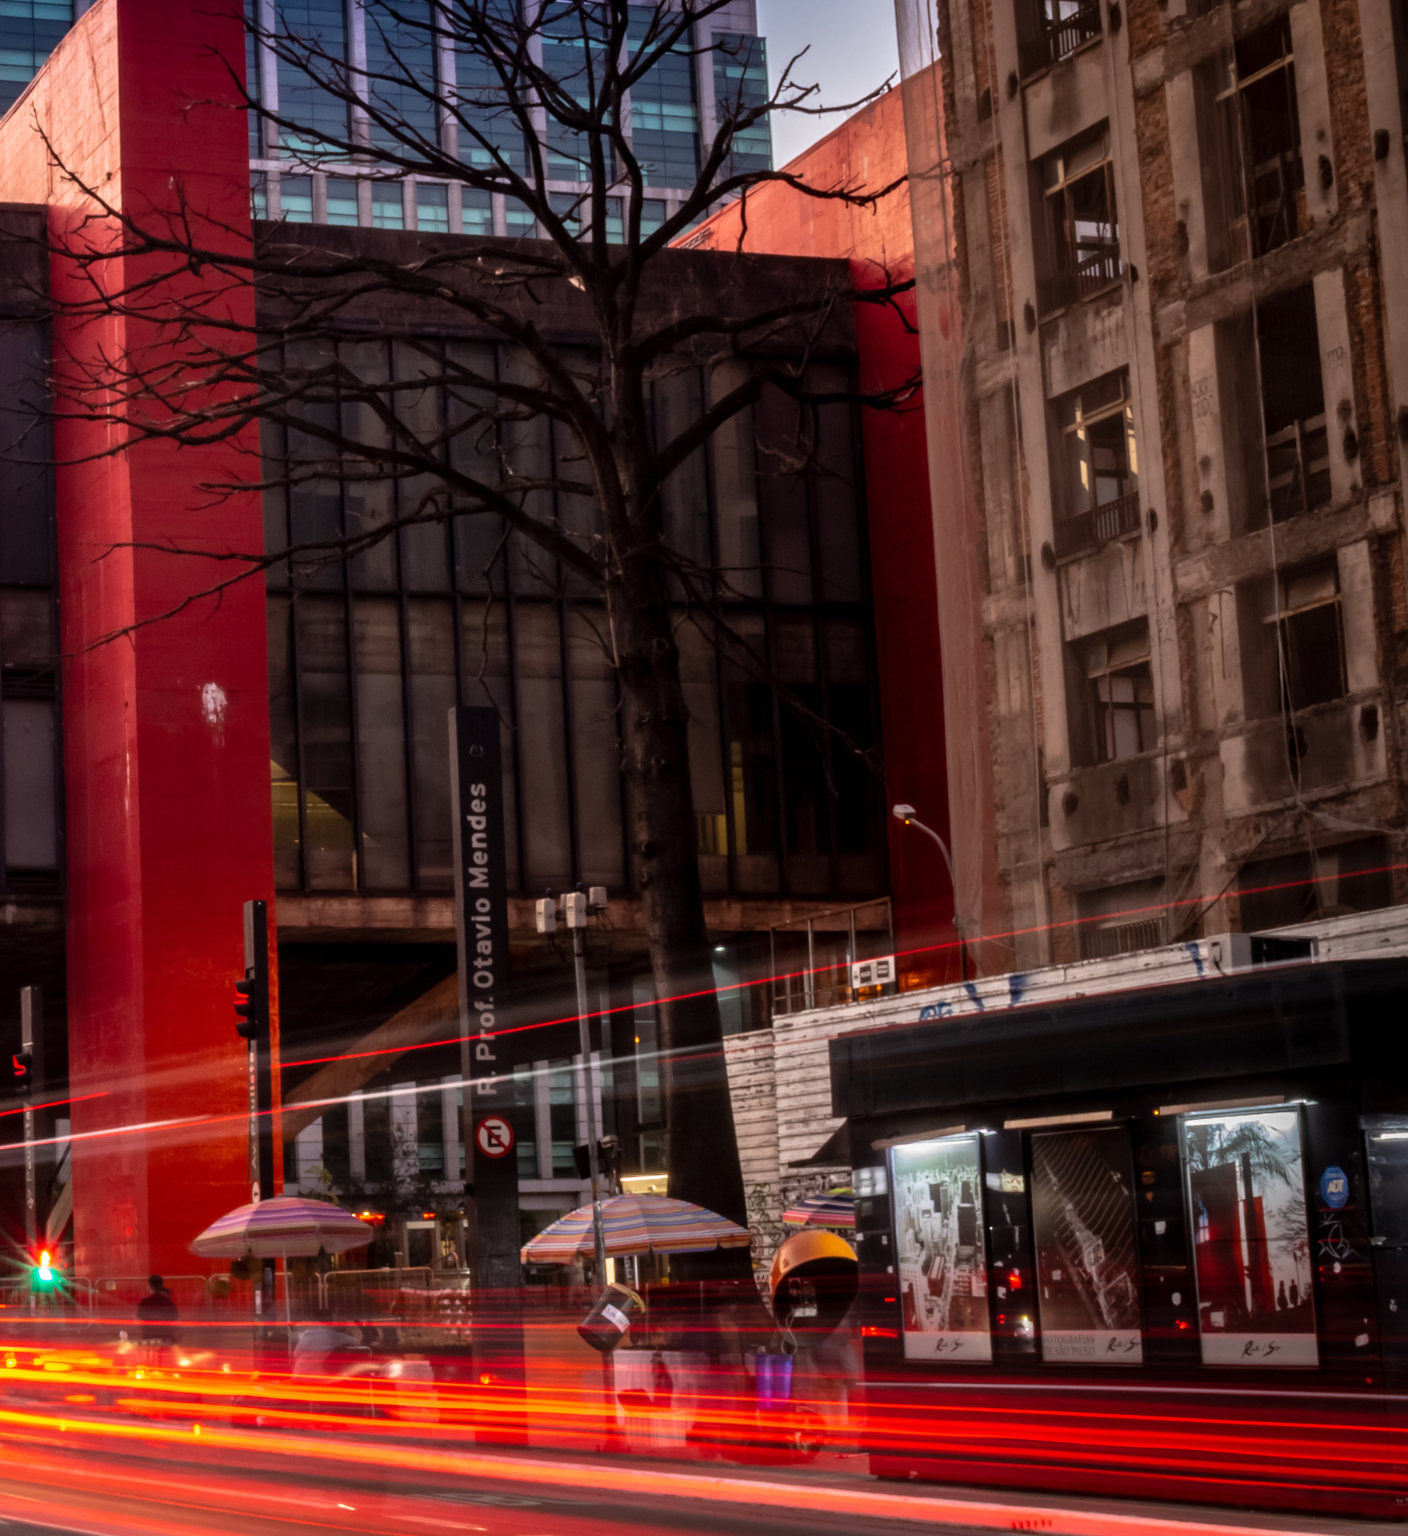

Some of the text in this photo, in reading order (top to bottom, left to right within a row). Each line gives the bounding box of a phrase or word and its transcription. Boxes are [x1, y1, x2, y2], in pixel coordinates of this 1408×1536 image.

[467, 783, 498, 1095] R. Prof. Otavio Mendes
[1327, 1179, 1344, 1193] ADT
[1043, 1333, 1095, 1344] FOTOGRAFIAS
[1055, 1344, 1070, 1356] SÃO
[1071, 1346, 1095, 1356] PAULO
